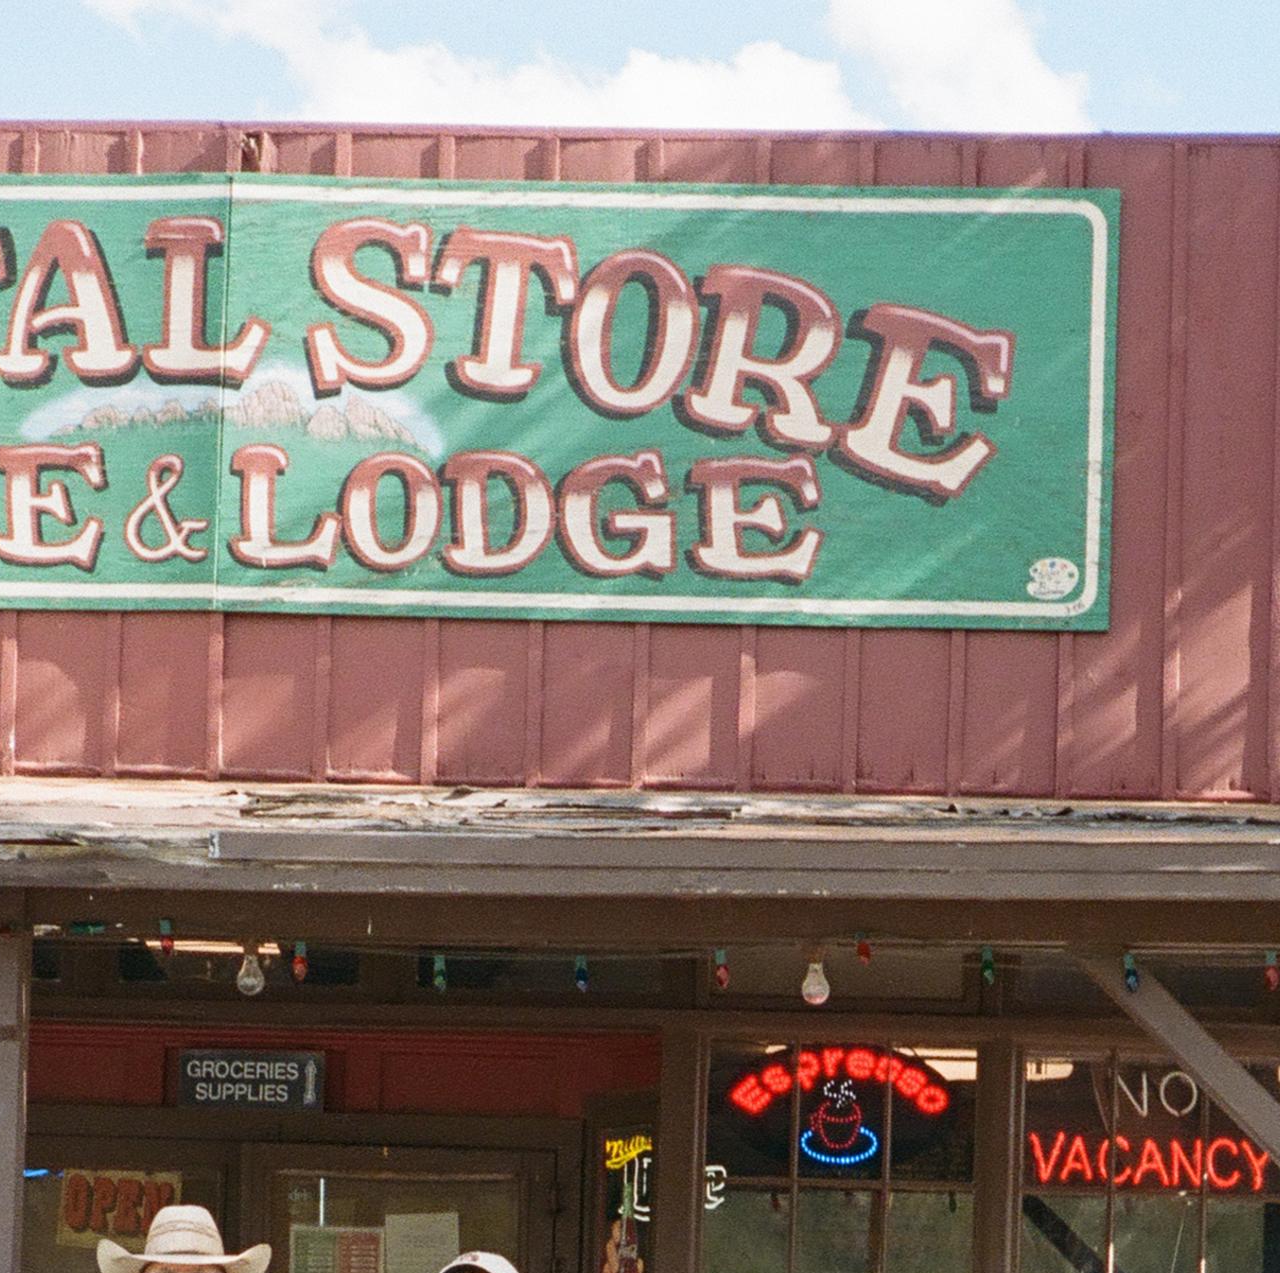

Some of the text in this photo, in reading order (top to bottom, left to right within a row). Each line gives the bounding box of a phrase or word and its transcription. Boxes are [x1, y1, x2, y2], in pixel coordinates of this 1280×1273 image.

[306, 216, 1015, 502] STORE
[122, 453, 210, 563] &
[227, 442, 824, 582] LODGE
[187, 1060, 299, 1080] GROCERIES
[195, 1082, 288, 1102] SUPPLIES
[1116, 1071, 1198, 1117] NO
[1028, 1131, 1269, 1191] VACANCY
